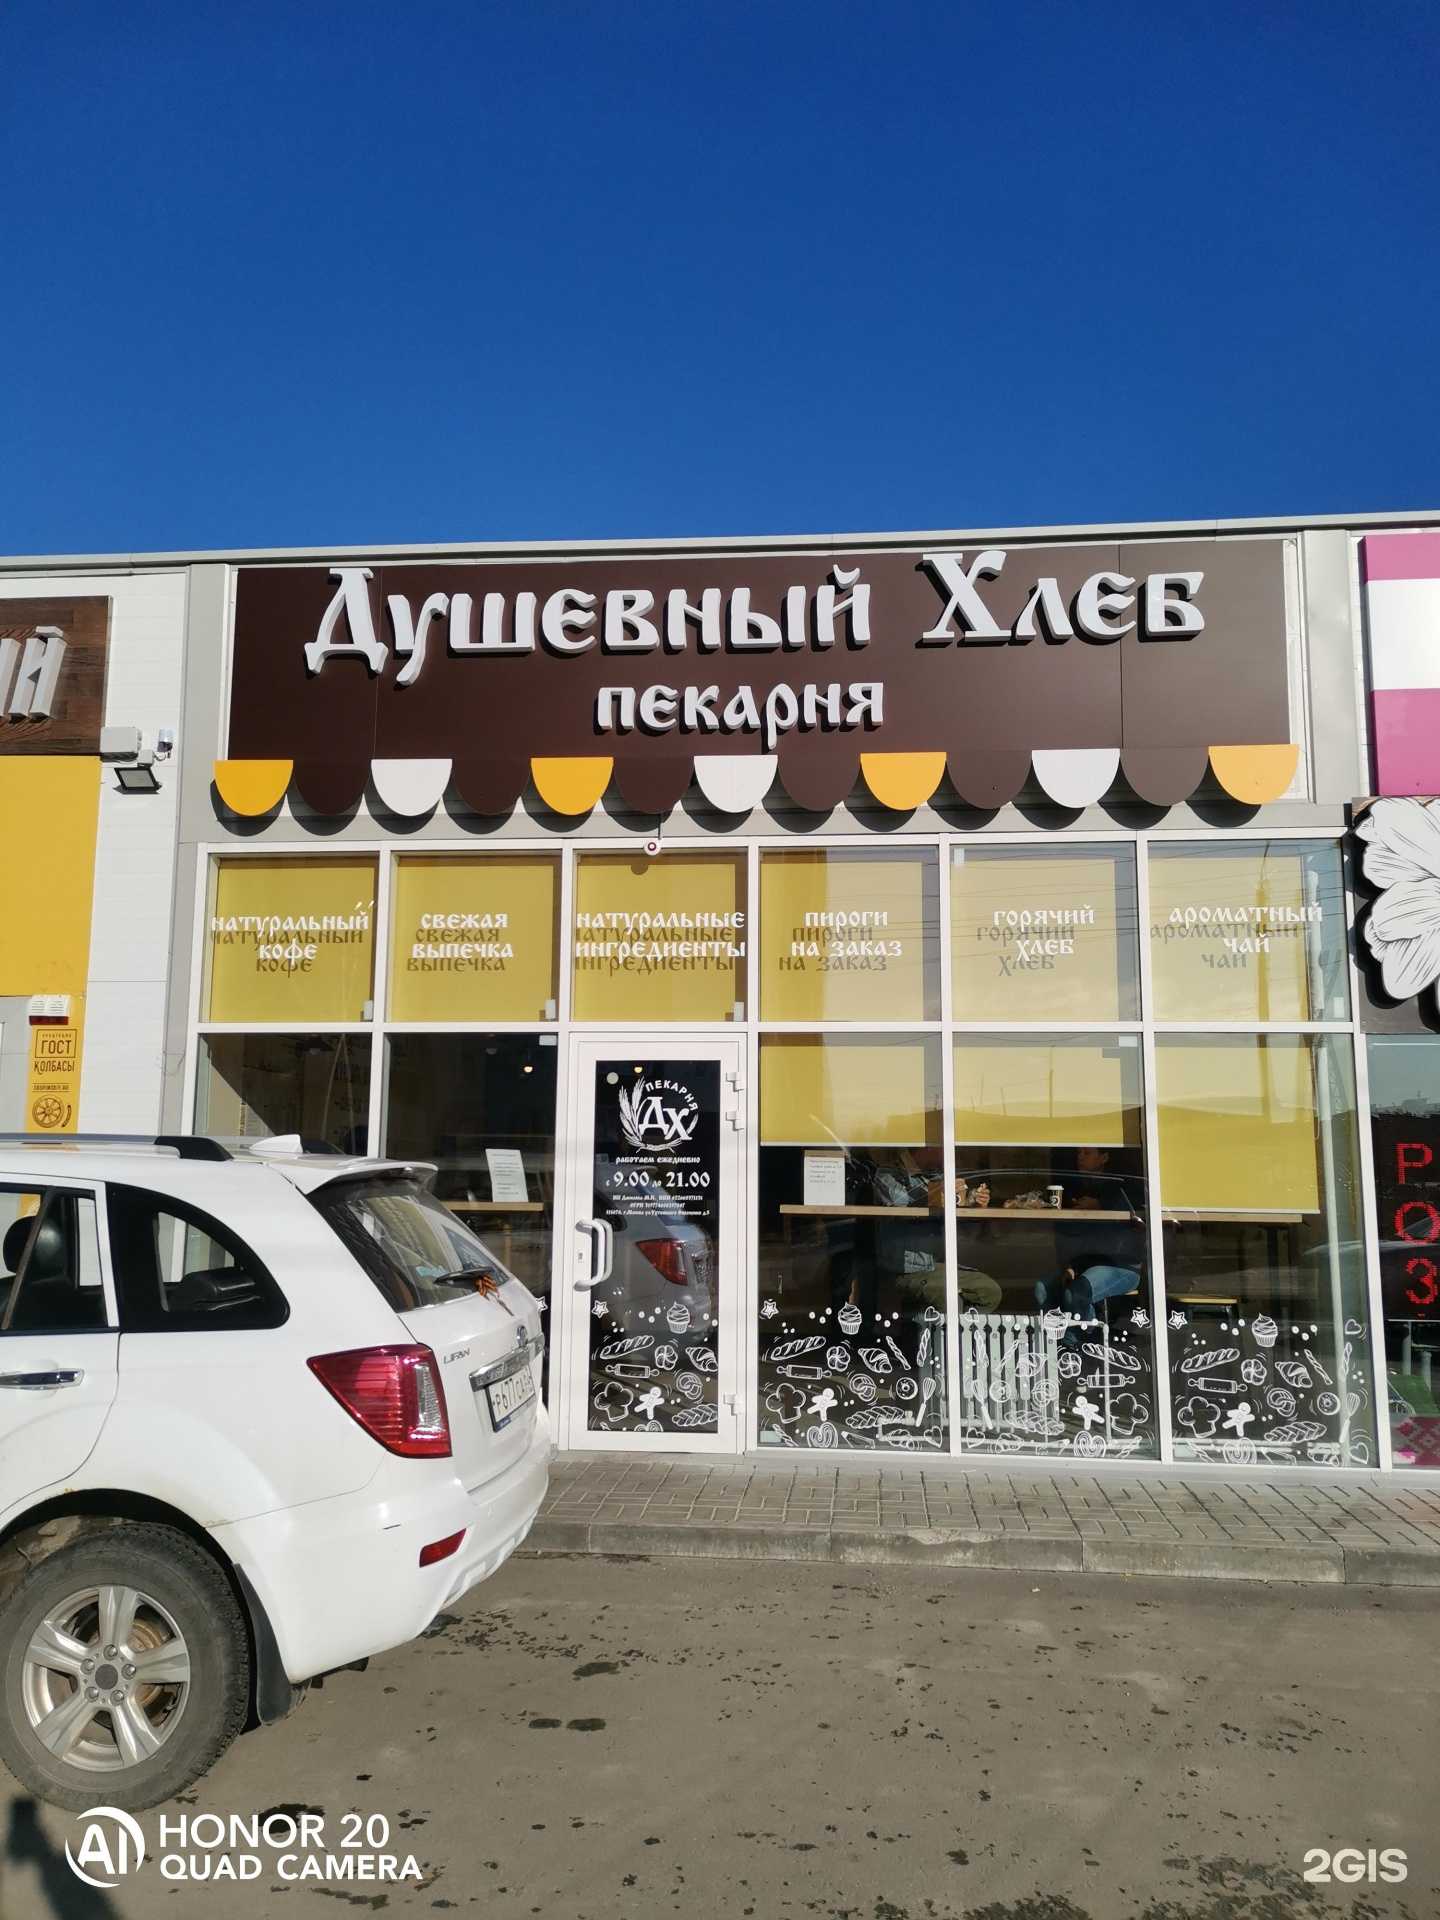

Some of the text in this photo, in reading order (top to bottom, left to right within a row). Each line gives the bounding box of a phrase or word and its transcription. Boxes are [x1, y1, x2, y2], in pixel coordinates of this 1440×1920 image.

[40, 1040, 71, 1054] ГОСТ
[34, 1060, 75, 1075] КОЛБАСЫ
[645, 1079, 699, 1112] ПЕКАРНЯ
[612, 1171, 650, 1188] 9.00
[665, 1171, 711, 1188] 21.00
